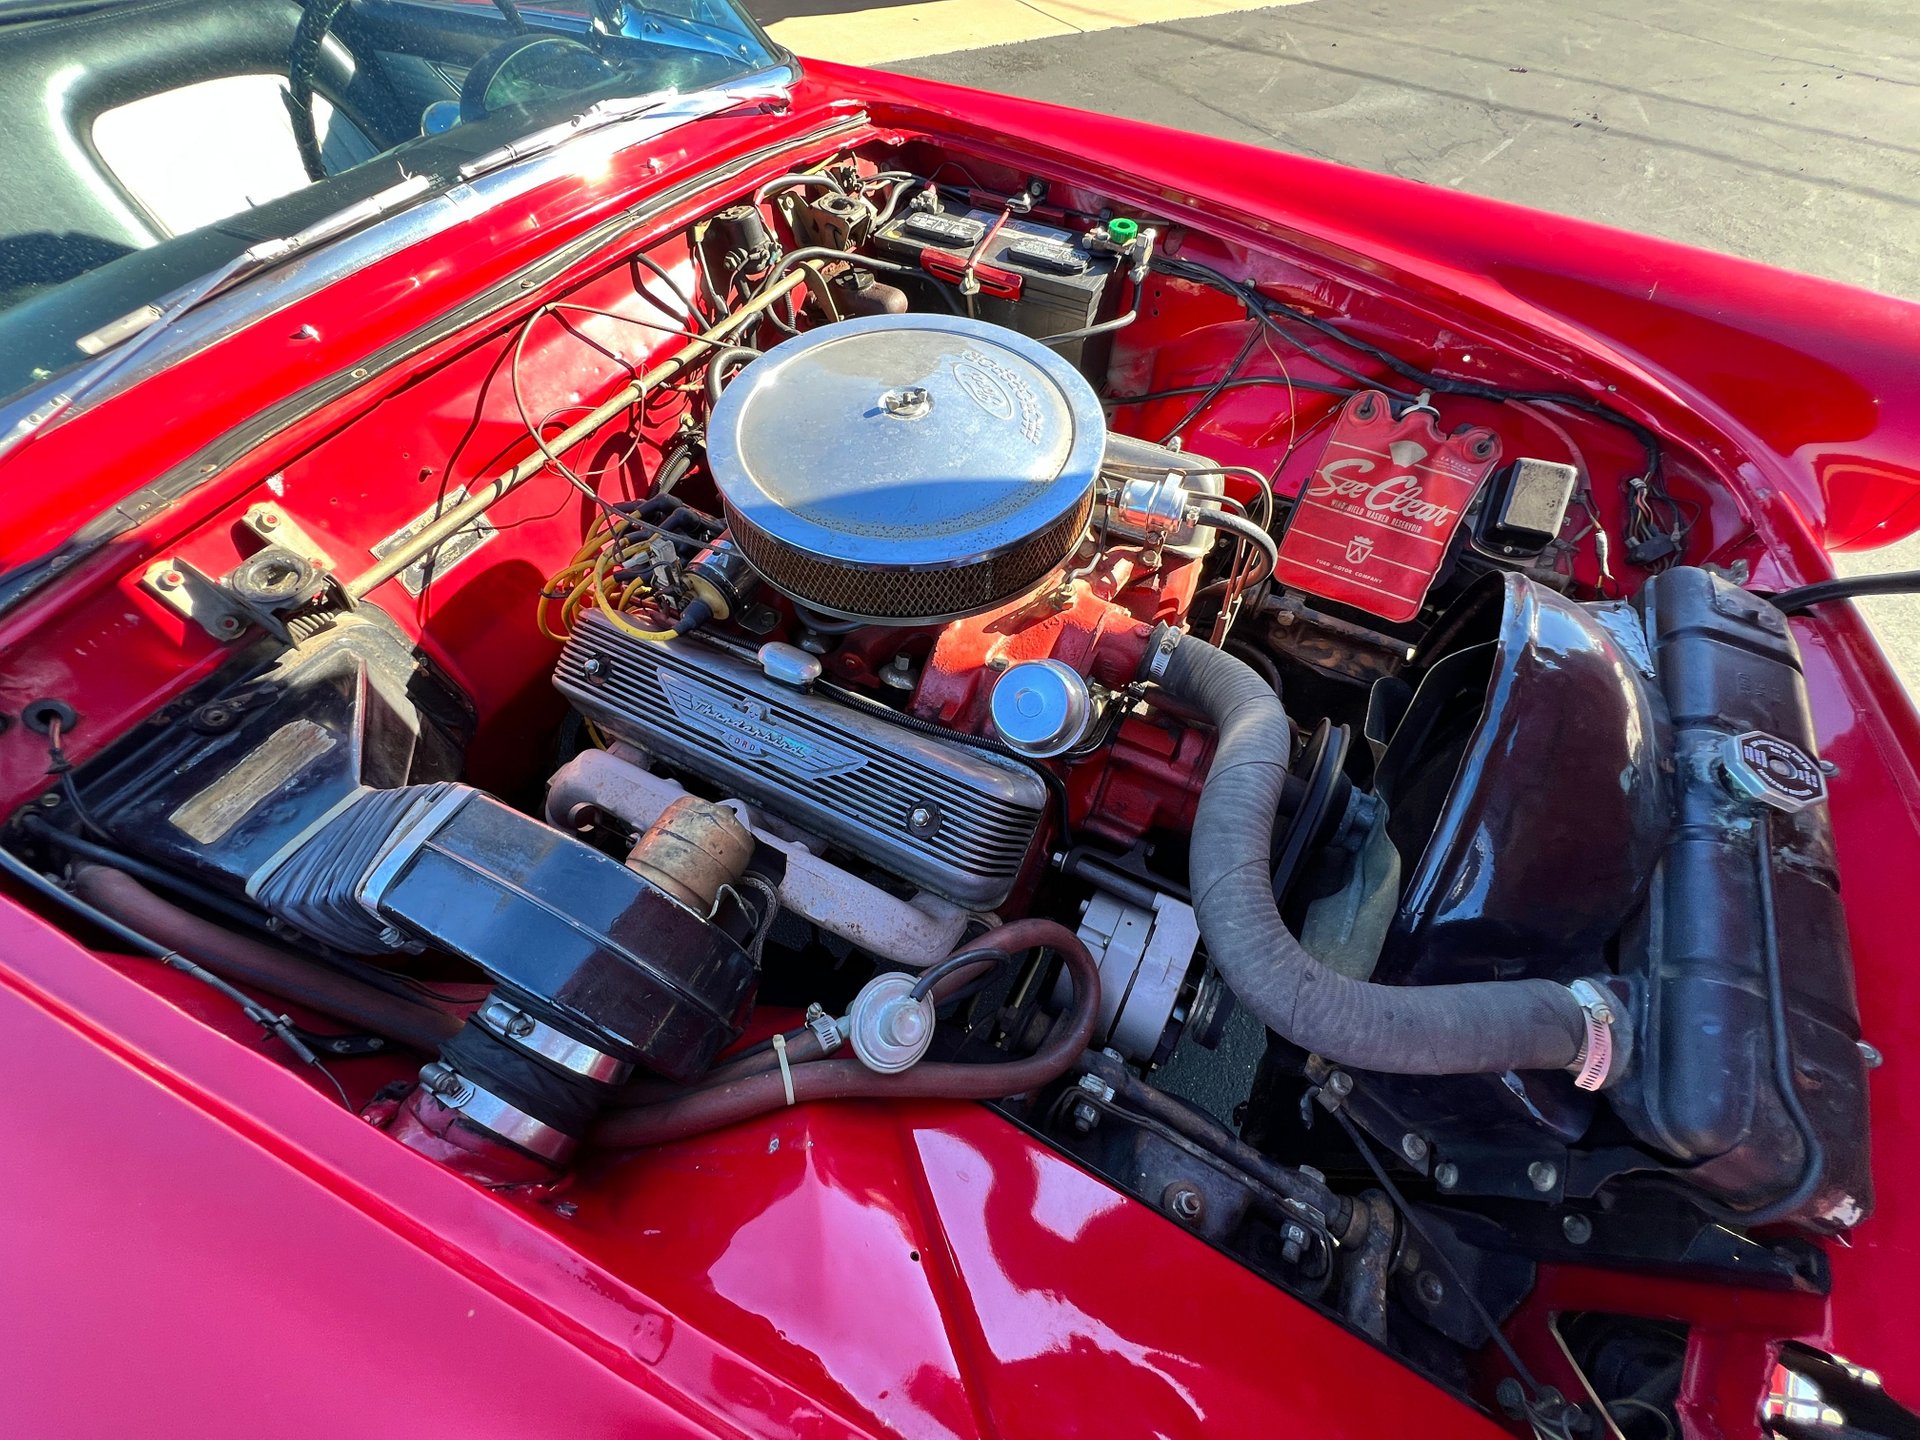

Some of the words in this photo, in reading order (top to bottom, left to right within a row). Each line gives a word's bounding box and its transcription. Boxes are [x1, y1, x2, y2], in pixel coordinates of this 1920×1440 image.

[1307, 458, 1375, 498] See
[1364, 475, 1450, 527] Clear
[1365, 509, 1390, 523] WASHER
[1390, 517, 1423, 534] RESERVOIR
[1332, 564, 1353, 575] MOTOR
[1354, 571, 1383, 584] COMPANY
[694, 701, 807, 760] Thunderbird
[727, 733, 757, 751] FORD
